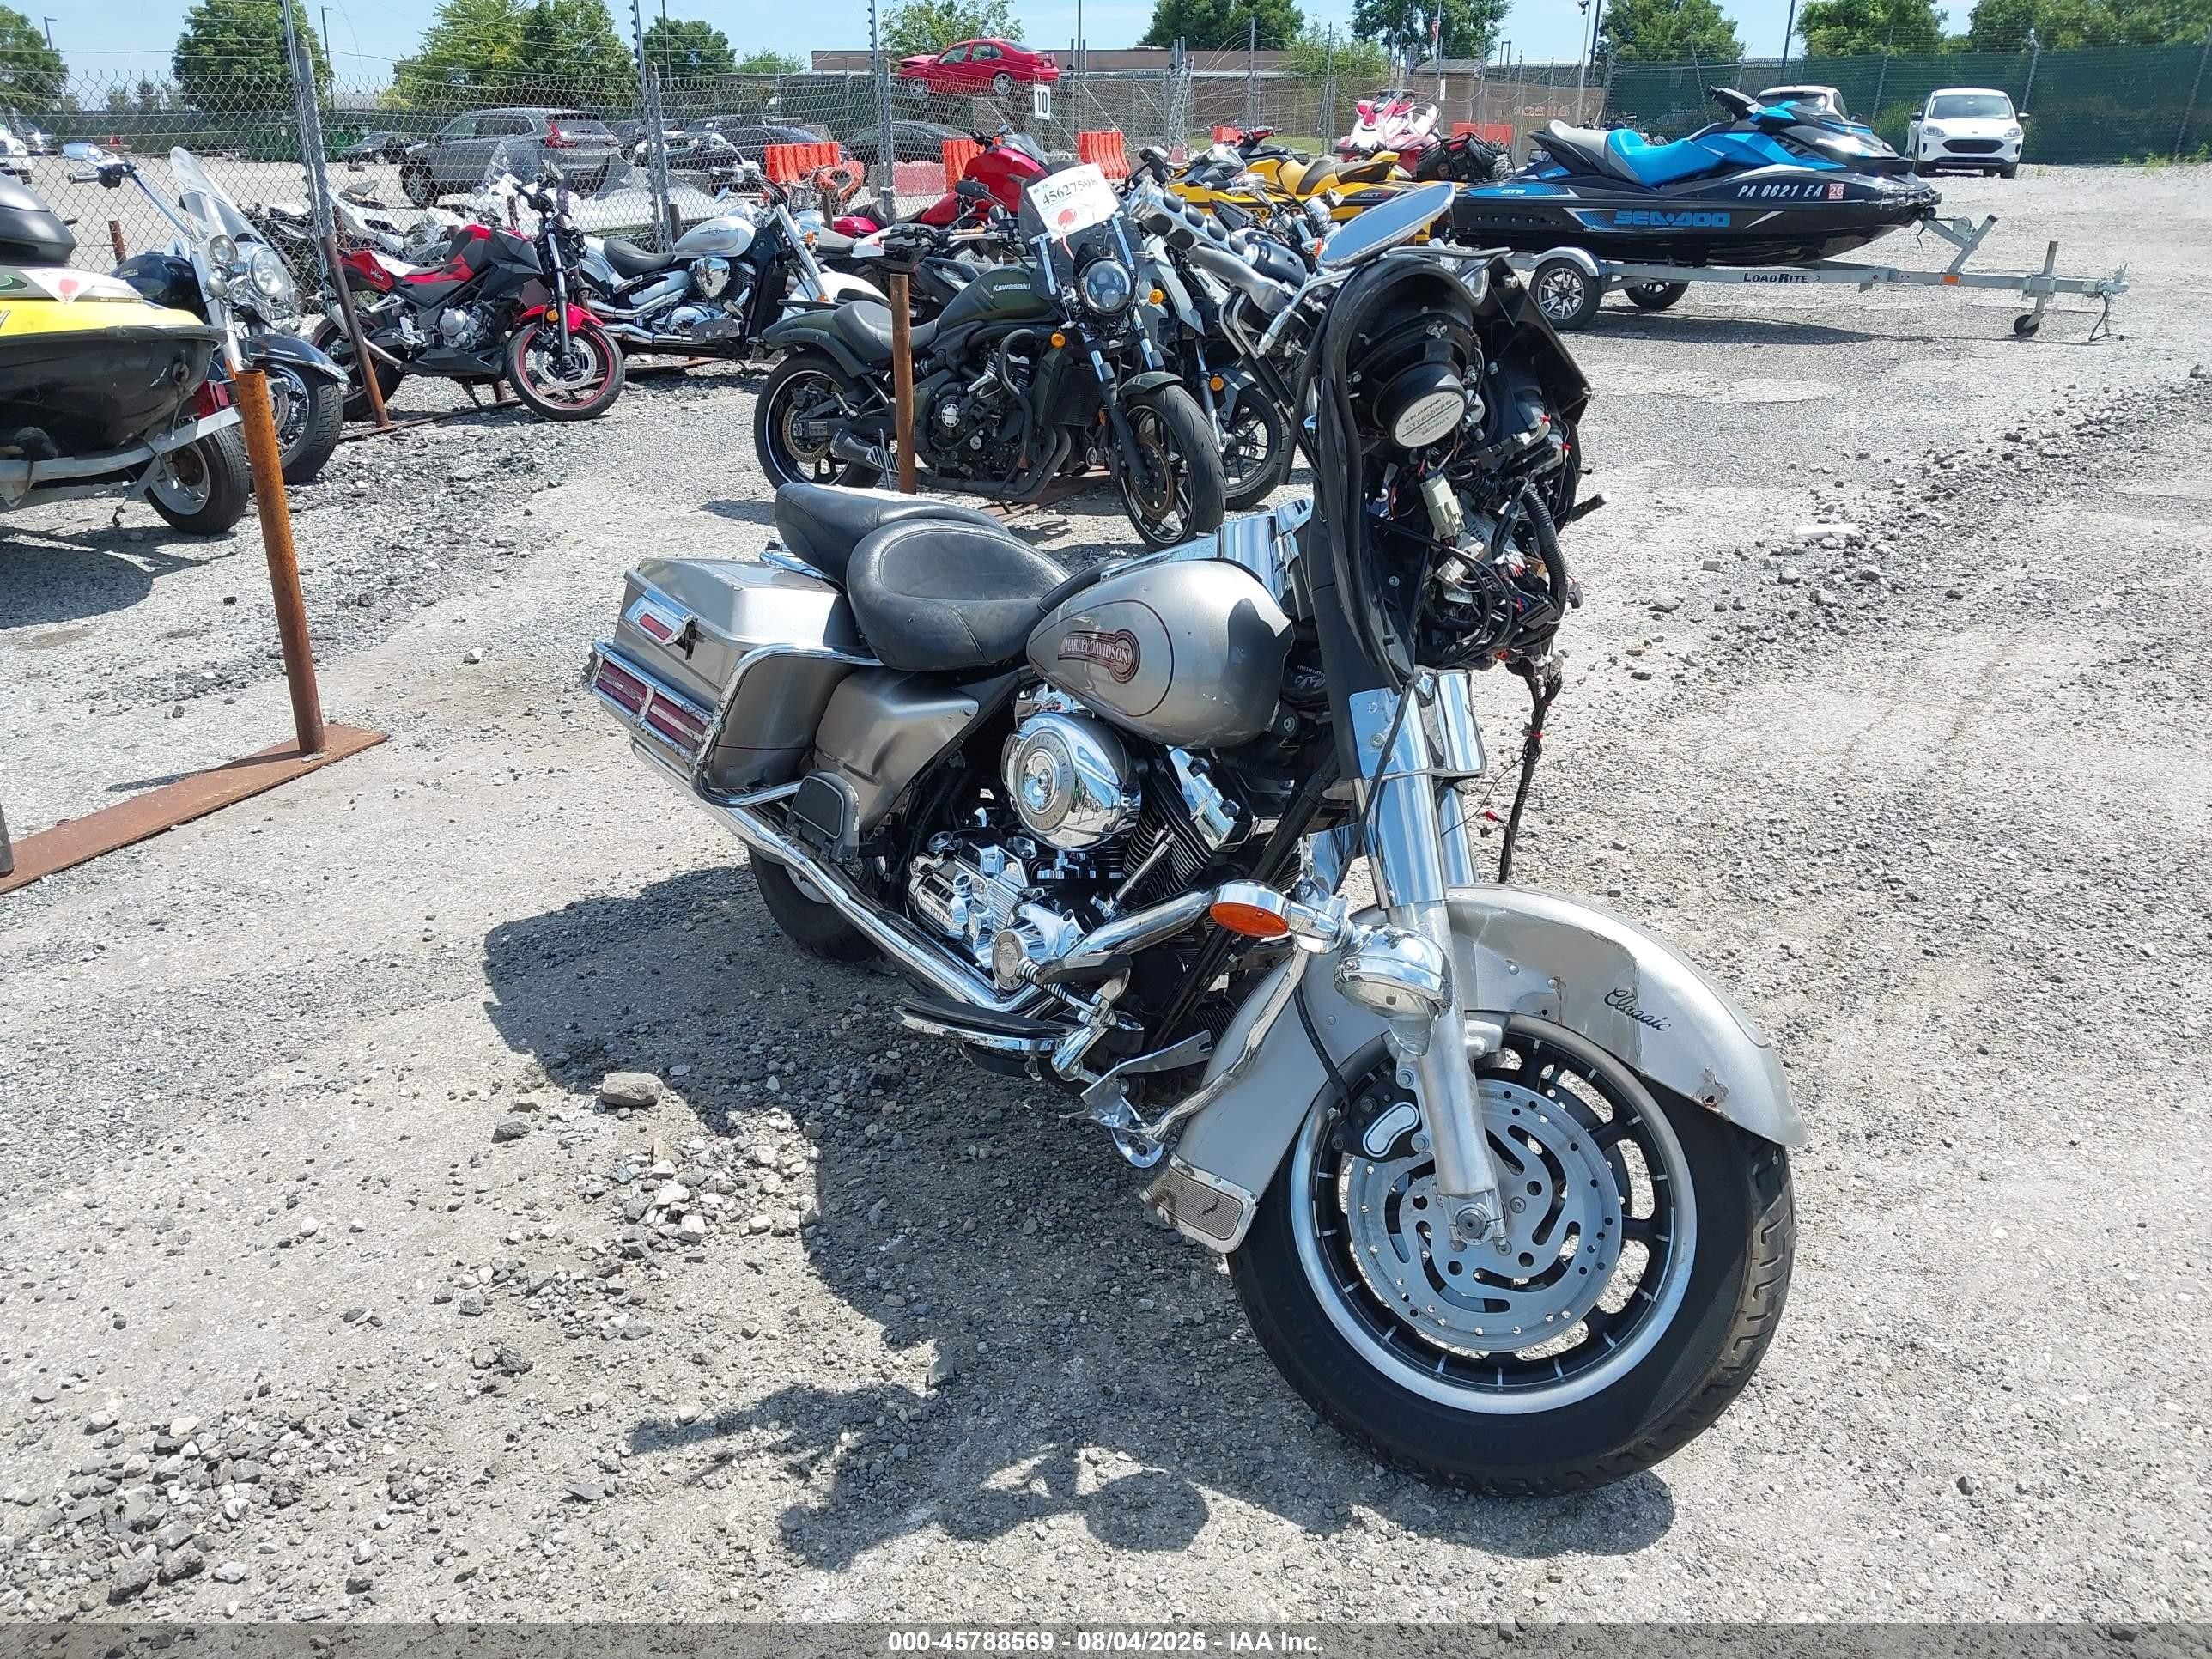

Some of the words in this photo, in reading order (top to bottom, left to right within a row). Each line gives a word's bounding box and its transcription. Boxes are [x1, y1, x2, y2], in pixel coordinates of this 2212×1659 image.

[1037, 90, 1048, 113] 10
[1042, 178, 1098, 204] 45627598
[1737, 185, 1757, 198] PA
[1803, 185, 1824, 198] EA
[1829, 185, 1844, 197] 26
[993, 282, 1031, 292] Kawasaki
